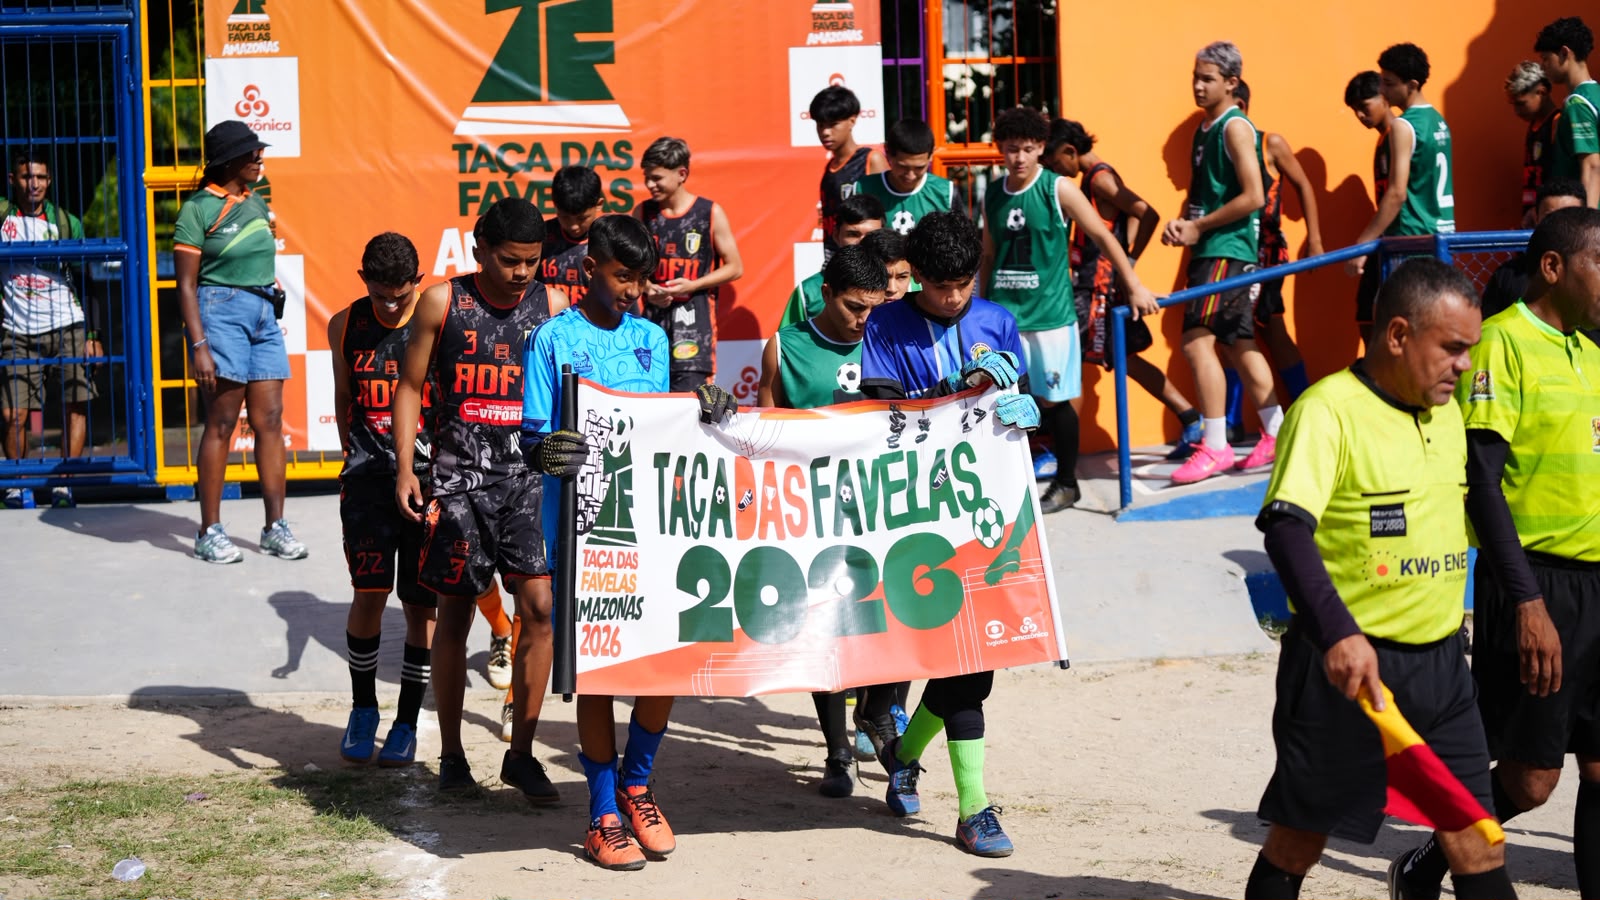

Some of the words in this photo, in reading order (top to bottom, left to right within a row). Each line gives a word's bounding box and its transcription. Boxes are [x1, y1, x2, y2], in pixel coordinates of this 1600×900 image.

[228, 32, 271, 41] FAVELAS
[253, 23, 271, 31] DAS
[813, 21, 855, 31] FAVELAS
[222, 41, 280, 56] AMAZONAS
[248, 118, 292, 131] zônica
[452, 142, 553, 179] TAÇA
[561, 140, 634, 172] DAS
[1436, 152, 1454, 208] 2
[458, 178, 634, 216] FAVES
[542, 258, 558, 278] 16
[463, 330, 477, 354] 3
[353, 350, 375, 372] 22
[454, 363, 524, 396] ADF
[479, 408, 523, 421] VITORI
[653, 452, 733, 540] TAÇA
[735, 456, 808, 541] DAS
[809, 441, 983, 538] FAVELAS
[356, 552, 384, 576] 22
[583, 549, 614, 571] TAÇA
[616, 551, 638, 570] DAS
[1400, 557, 1440, 577] KWp
[1444, 552, 1466, 571] ENE
[580, 571, 637, 593] FAVELAS
[676, 532, 964, 644] 2026
[580, 623, 621, 657] 2026
